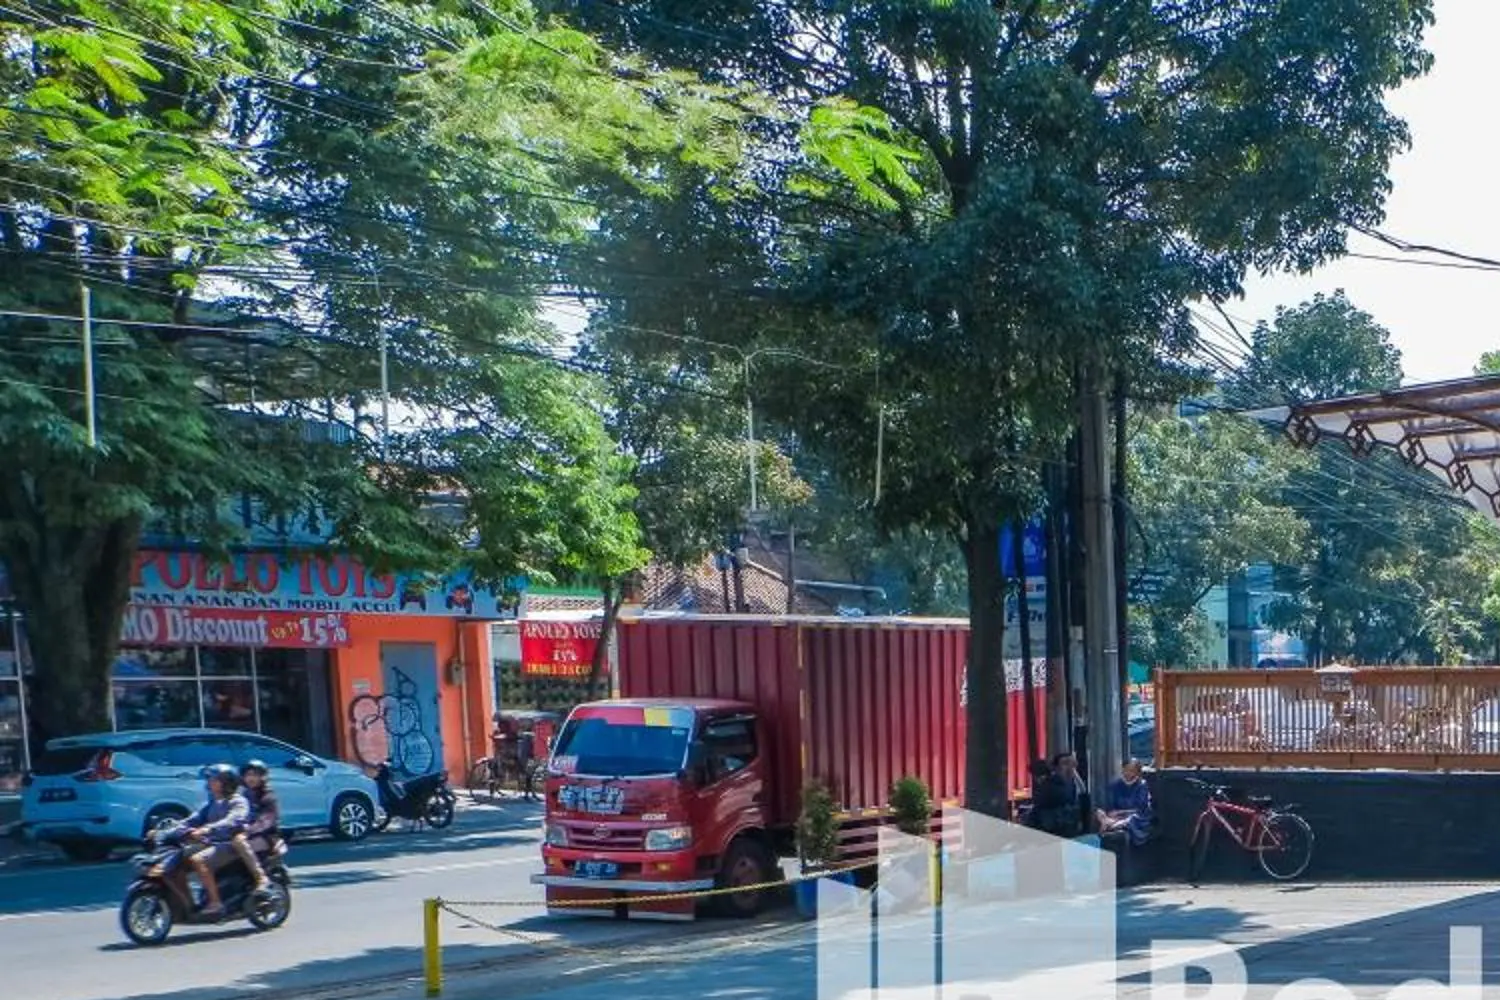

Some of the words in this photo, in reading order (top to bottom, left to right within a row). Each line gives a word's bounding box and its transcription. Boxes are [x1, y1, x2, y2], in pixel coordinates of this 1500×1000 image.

[130, 551, 279, 594] POLLO
[134, 592, 174, 604] NAN
[182, 594, 237, 607] ANAK
[243, 597, 281, 609] DAN
[287, 599, 341, 611] MOBIL
[165, 608, 268, 645] Discount
[299, 613, 348, 646] 15%
